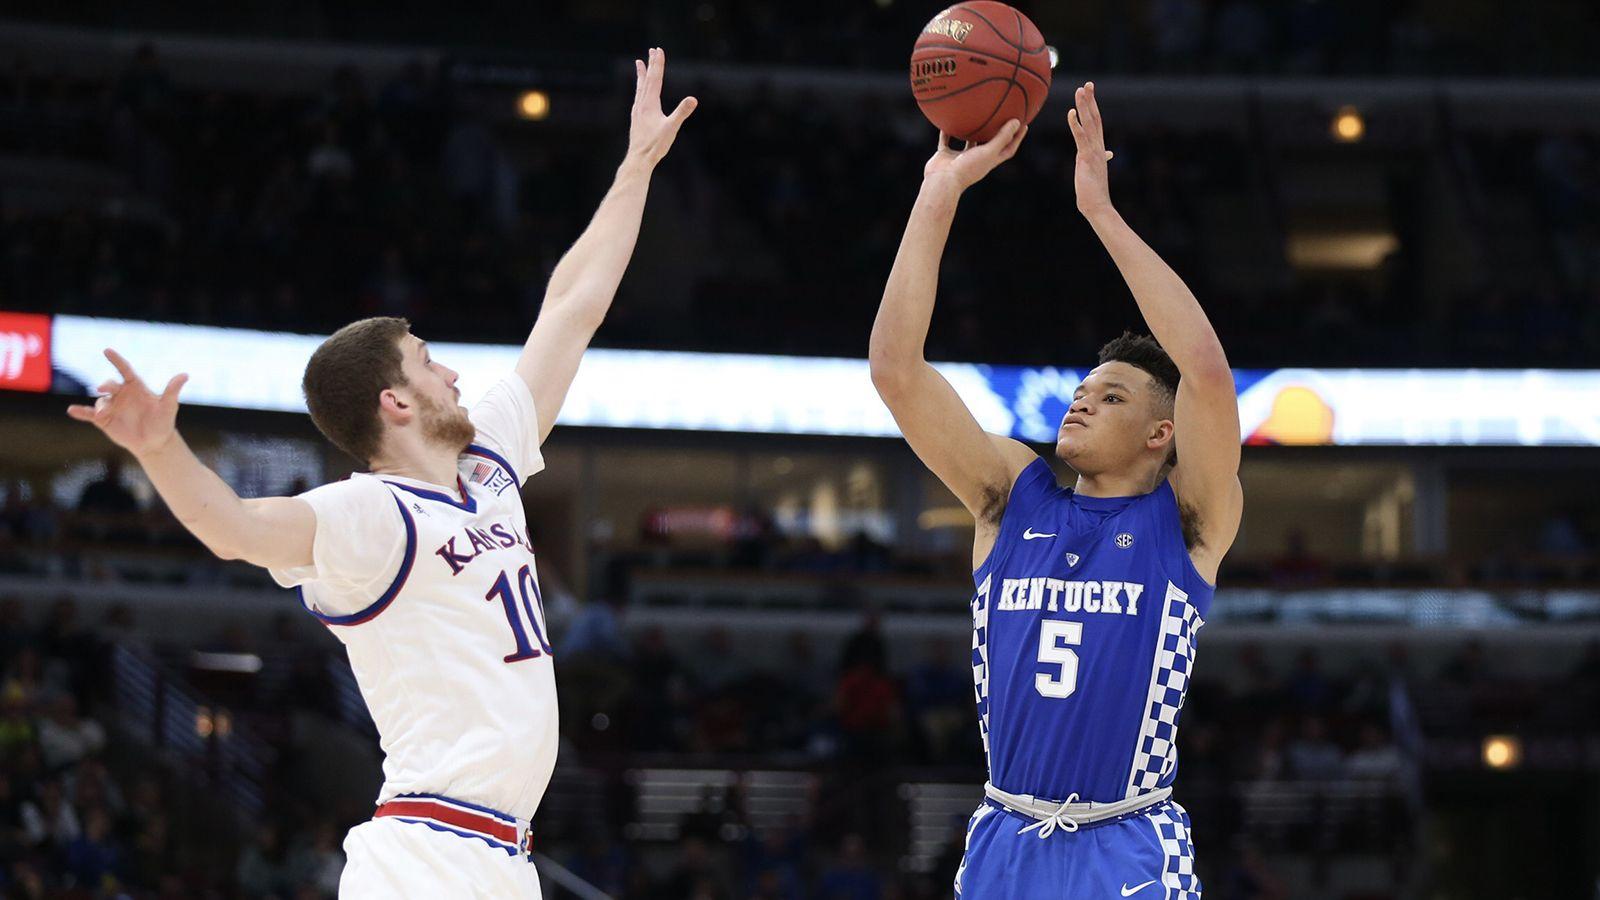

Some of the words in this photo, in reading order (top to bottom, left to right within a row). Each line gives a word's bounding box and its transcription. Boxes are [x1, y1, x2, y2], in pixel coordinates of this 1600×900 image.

[1116, 533, 1132, 547] SEC
[485, 564, 554, 663] 10
[997, 577, 1144, 616] KENTUCKY
[1034, 619, 1084, 699] 5
